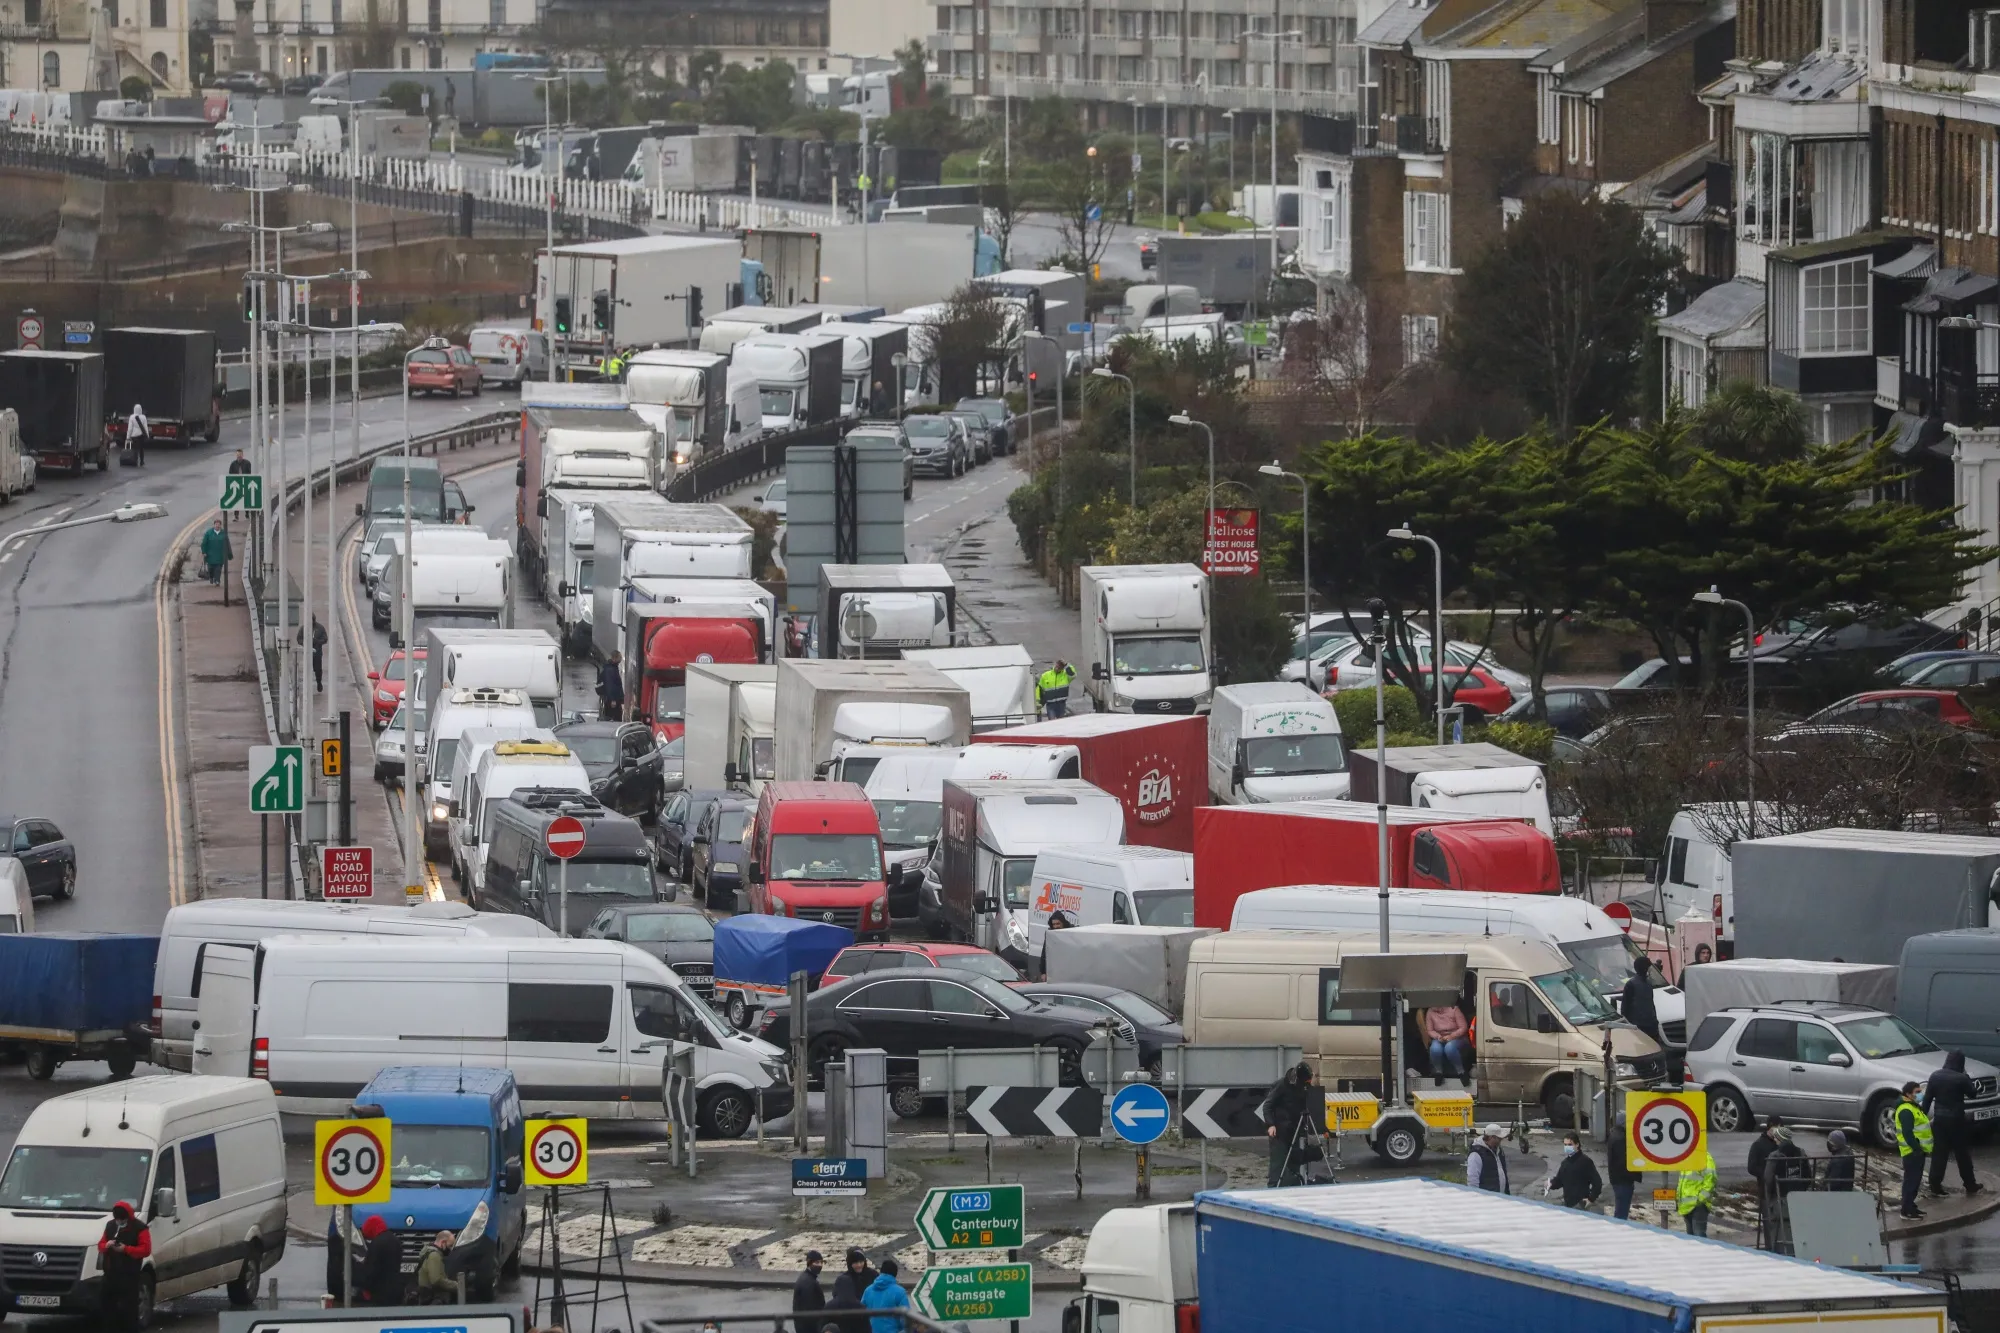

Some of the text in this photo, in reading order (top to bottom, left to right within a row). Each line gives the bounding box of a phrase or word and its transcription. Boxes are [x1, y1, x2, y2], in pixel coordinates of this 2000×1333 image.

[1208, 525, 1255, 536] Bellrose
[1230, 540, 1255, 548] HOUSE
[1203, 550, 1259, 563] ROOMS
[1304, 710, 1326, 720] home
[1140, 806, 1171, 820] INTEKTUR
[336, 852, 361, 861] NEW
[333, 863, 364, 872] ROAD
[328, 873, 369, 883] LAYOUT
[329, 884, 367, 894] AHEAD
[1336, 1105, 1360, 1120] MVIS
[1643, 1117, 1691, 1146] 30
[538, 1140, 575, 1164] 30
[332, 1146, 377, 1177] 30
[812, 1162, 847, 1176] aferry
[796, 1180, 862, 1188] Cheap Ferry Tickets
[951, 1217, 1019, 1230] Canterbury
[951, 1232, 969, 1244] A2
[946, 1267, 1026, 1284] Deal (A258)
[946, 1288, 1006, 1302] Ramsgate
[945, 1302, 994, 1317] (A256)
